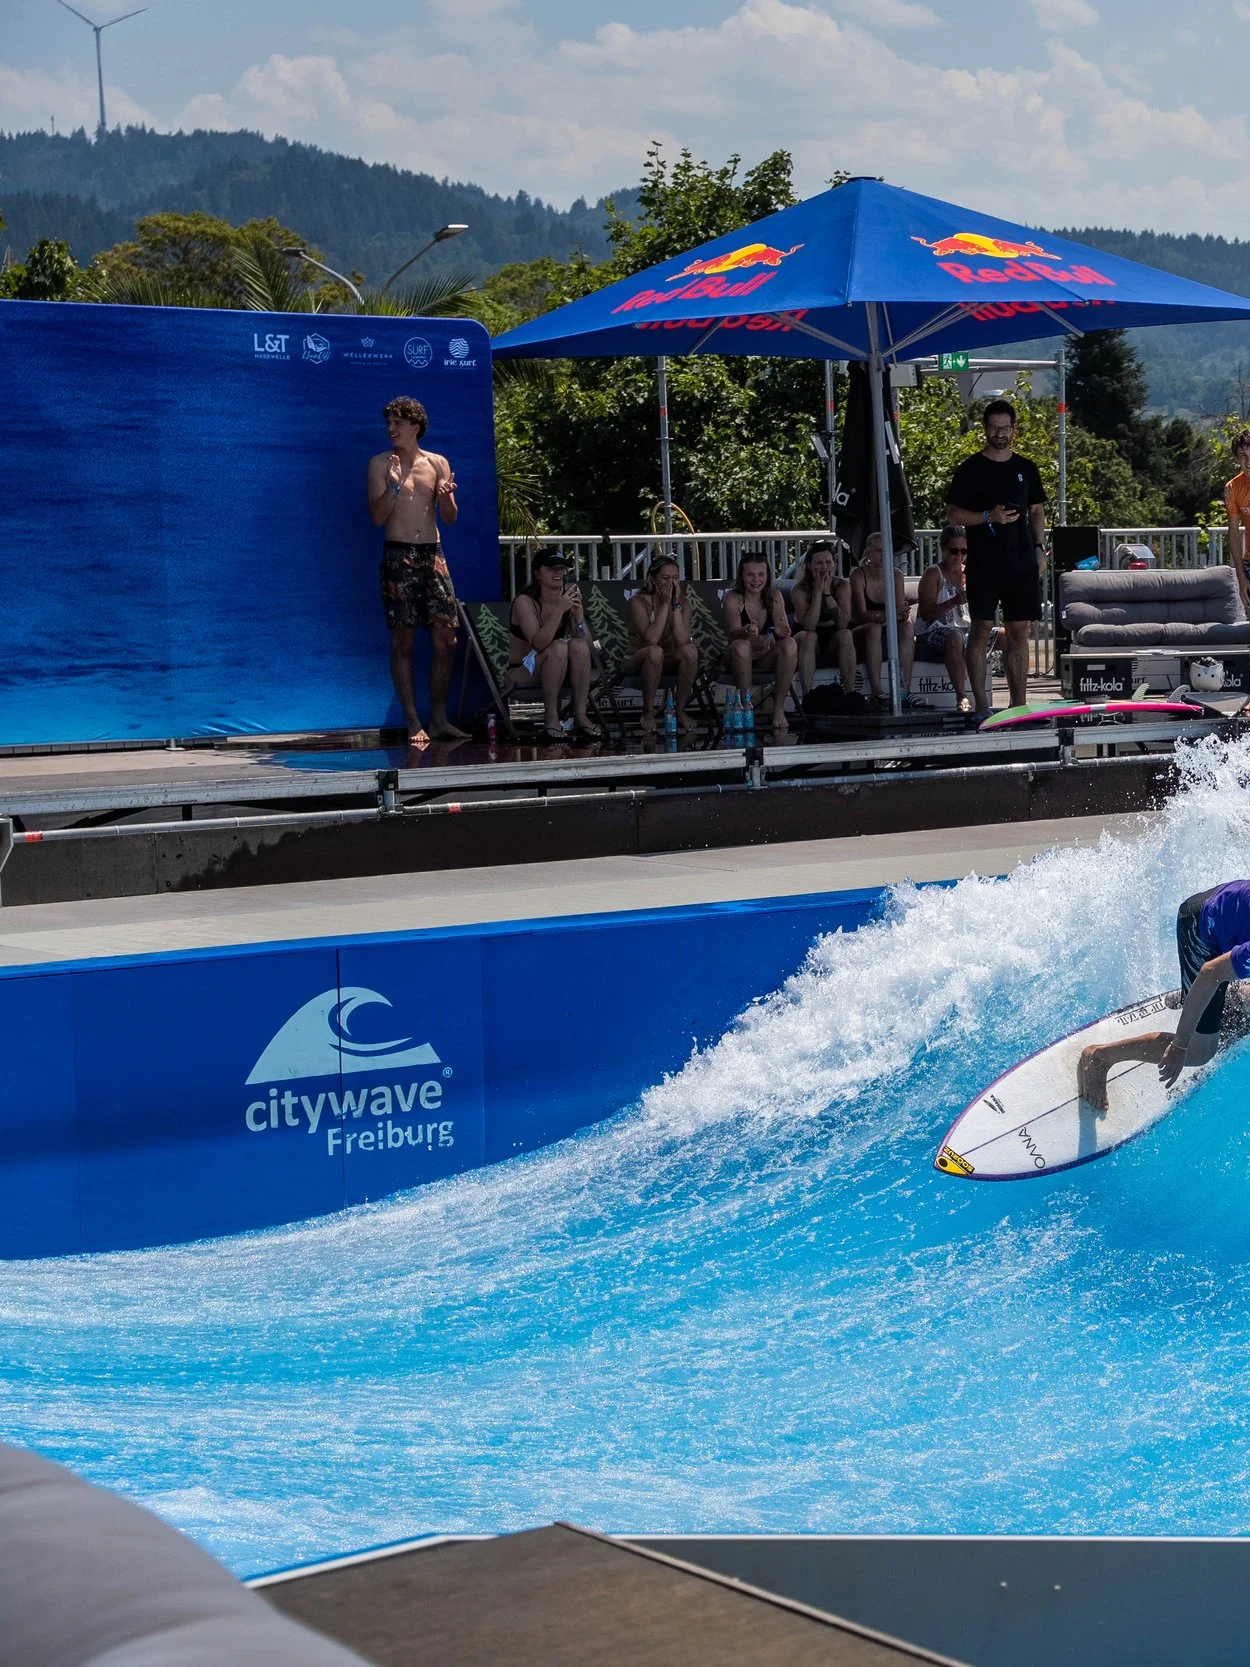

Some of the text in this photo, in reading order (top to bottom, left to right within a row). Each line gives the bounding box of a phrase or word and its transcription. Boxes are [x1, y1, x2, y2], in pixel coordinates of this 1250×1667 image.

[936, 260, 1117, 286] Red Bull
[611, 271, 778, 315] Red Bull
[253, 333, 290, 353] L&T
[407, 344, 429, 355] SURF
[919, 677, 955, 693] fritz-ko
[1079, 677, 1123, 692] fritz-kola
[245, 1079, 443, 1134] citywave
[326, 1120, 454, 1157] Freiburg
[943, 1146, 974, 1172] SOORUZ
